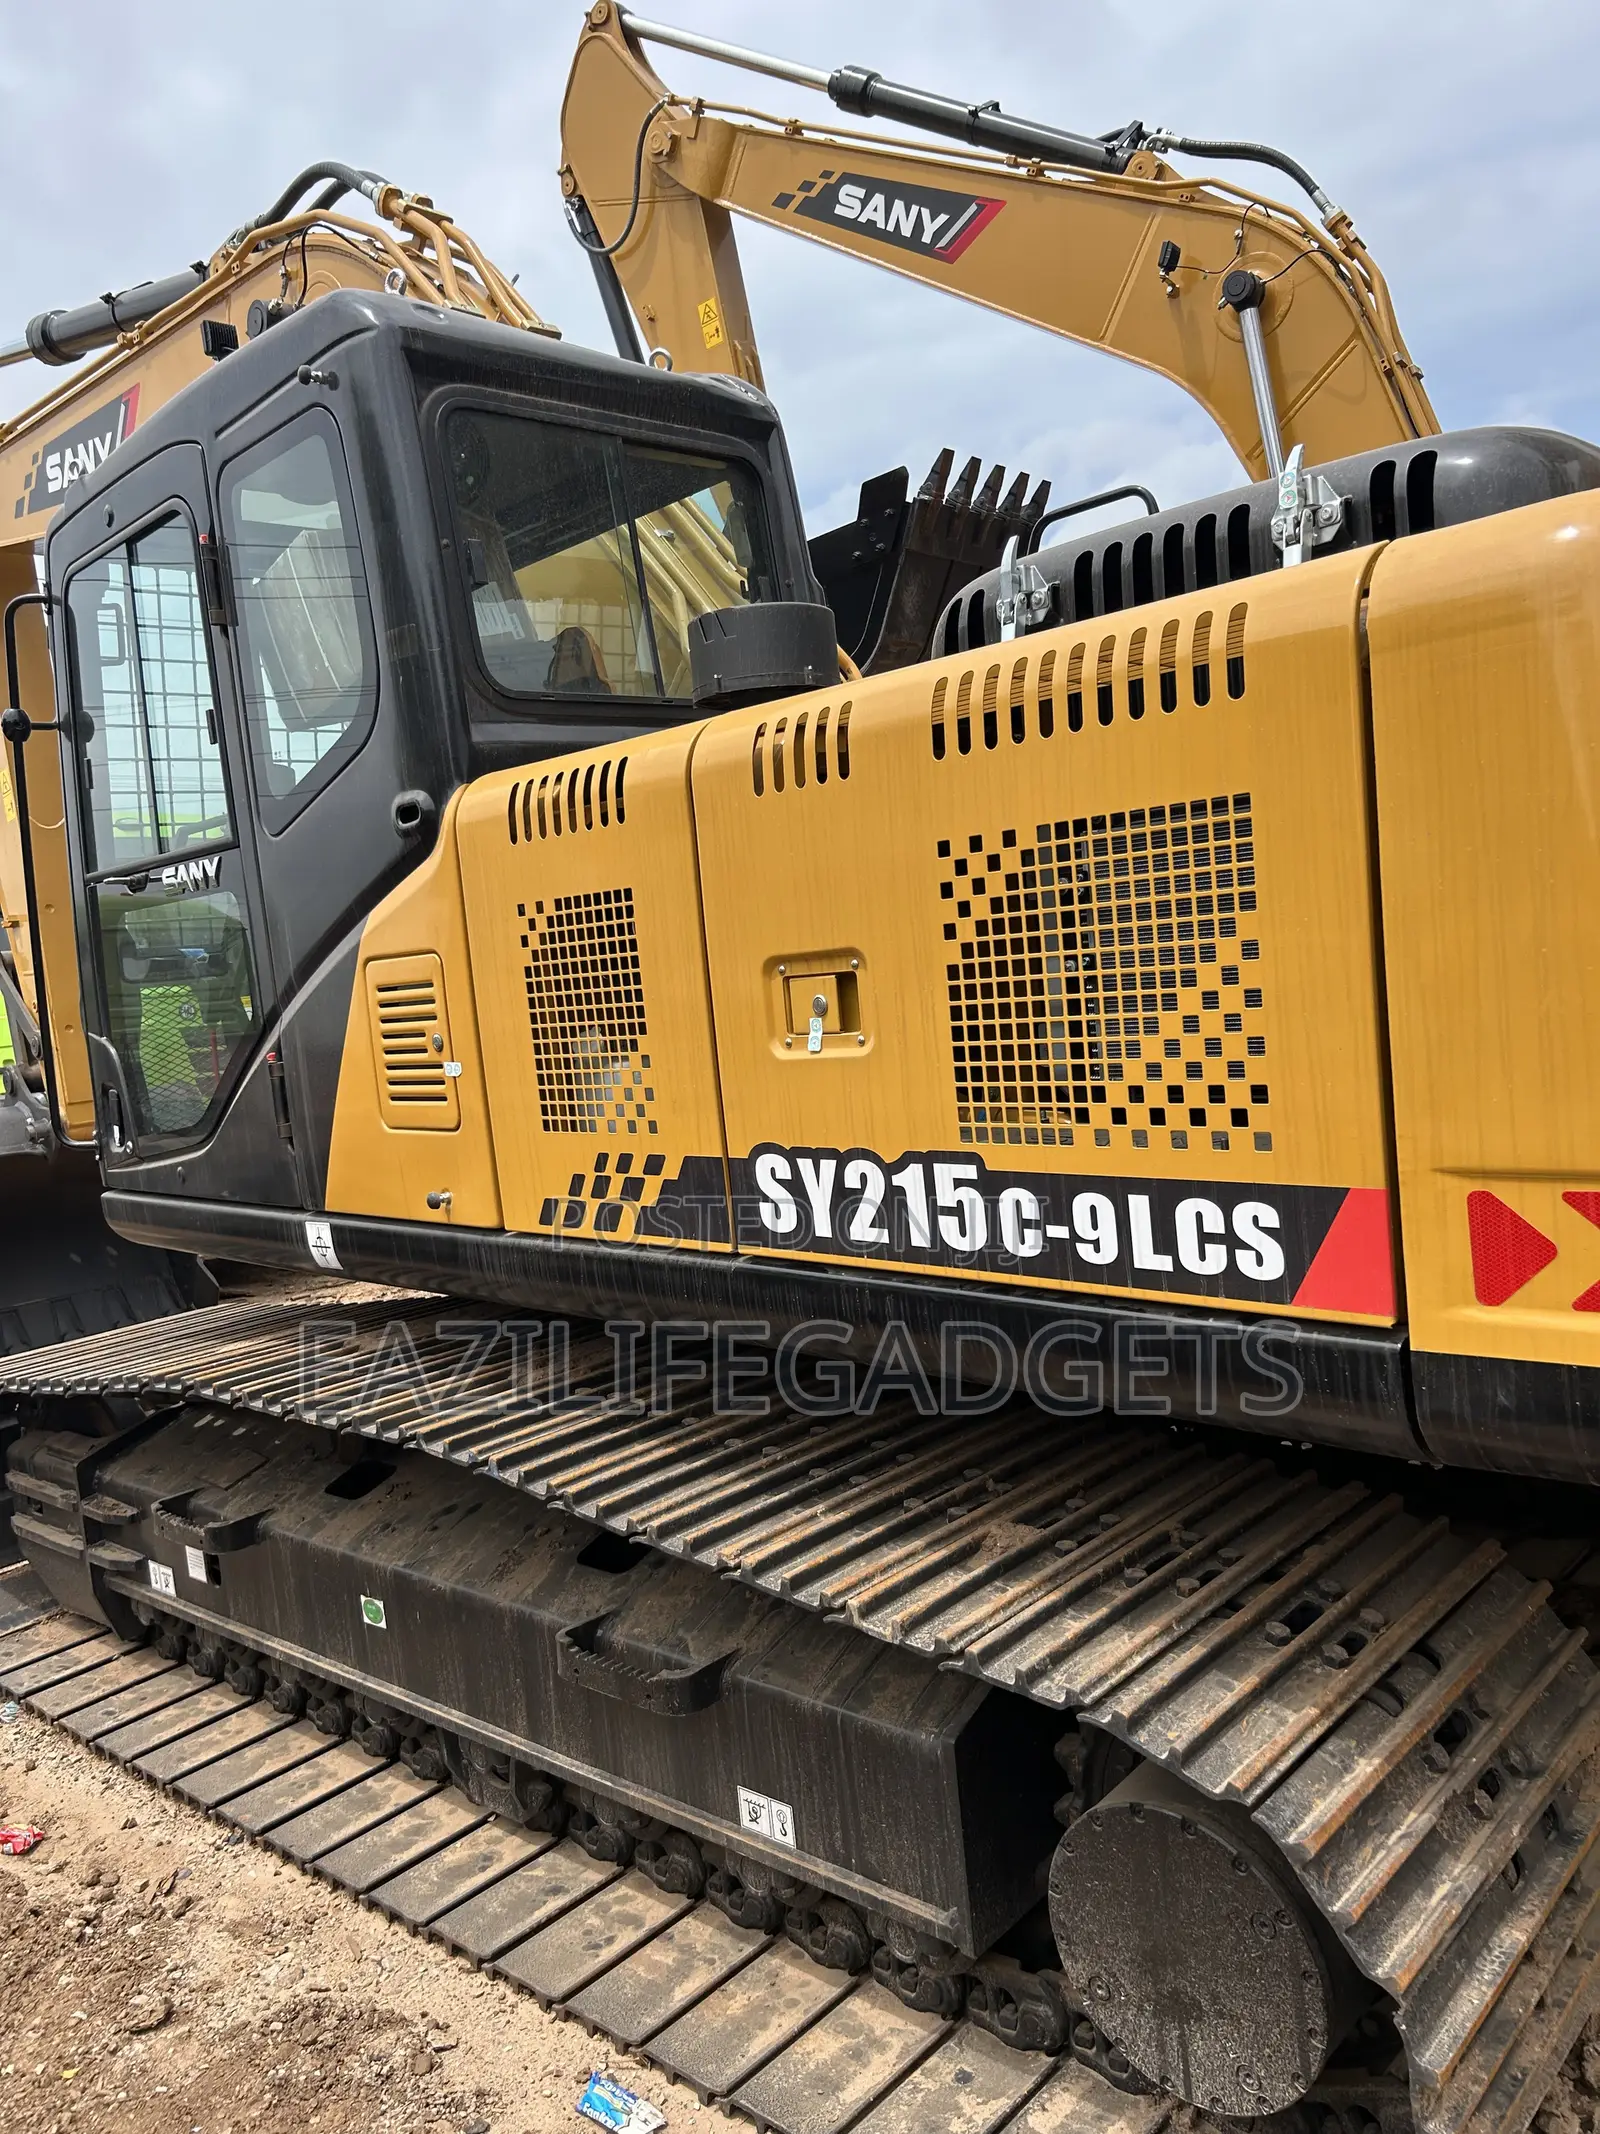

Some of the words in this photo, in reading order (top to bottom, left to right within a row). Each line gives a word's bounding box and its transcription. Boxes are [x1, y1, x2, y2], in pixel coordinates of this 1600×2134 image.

[834, 184, 950, 244] SANY
[46, 431, 113, 493] SANY
[162, 856, 221, 896] SANY
